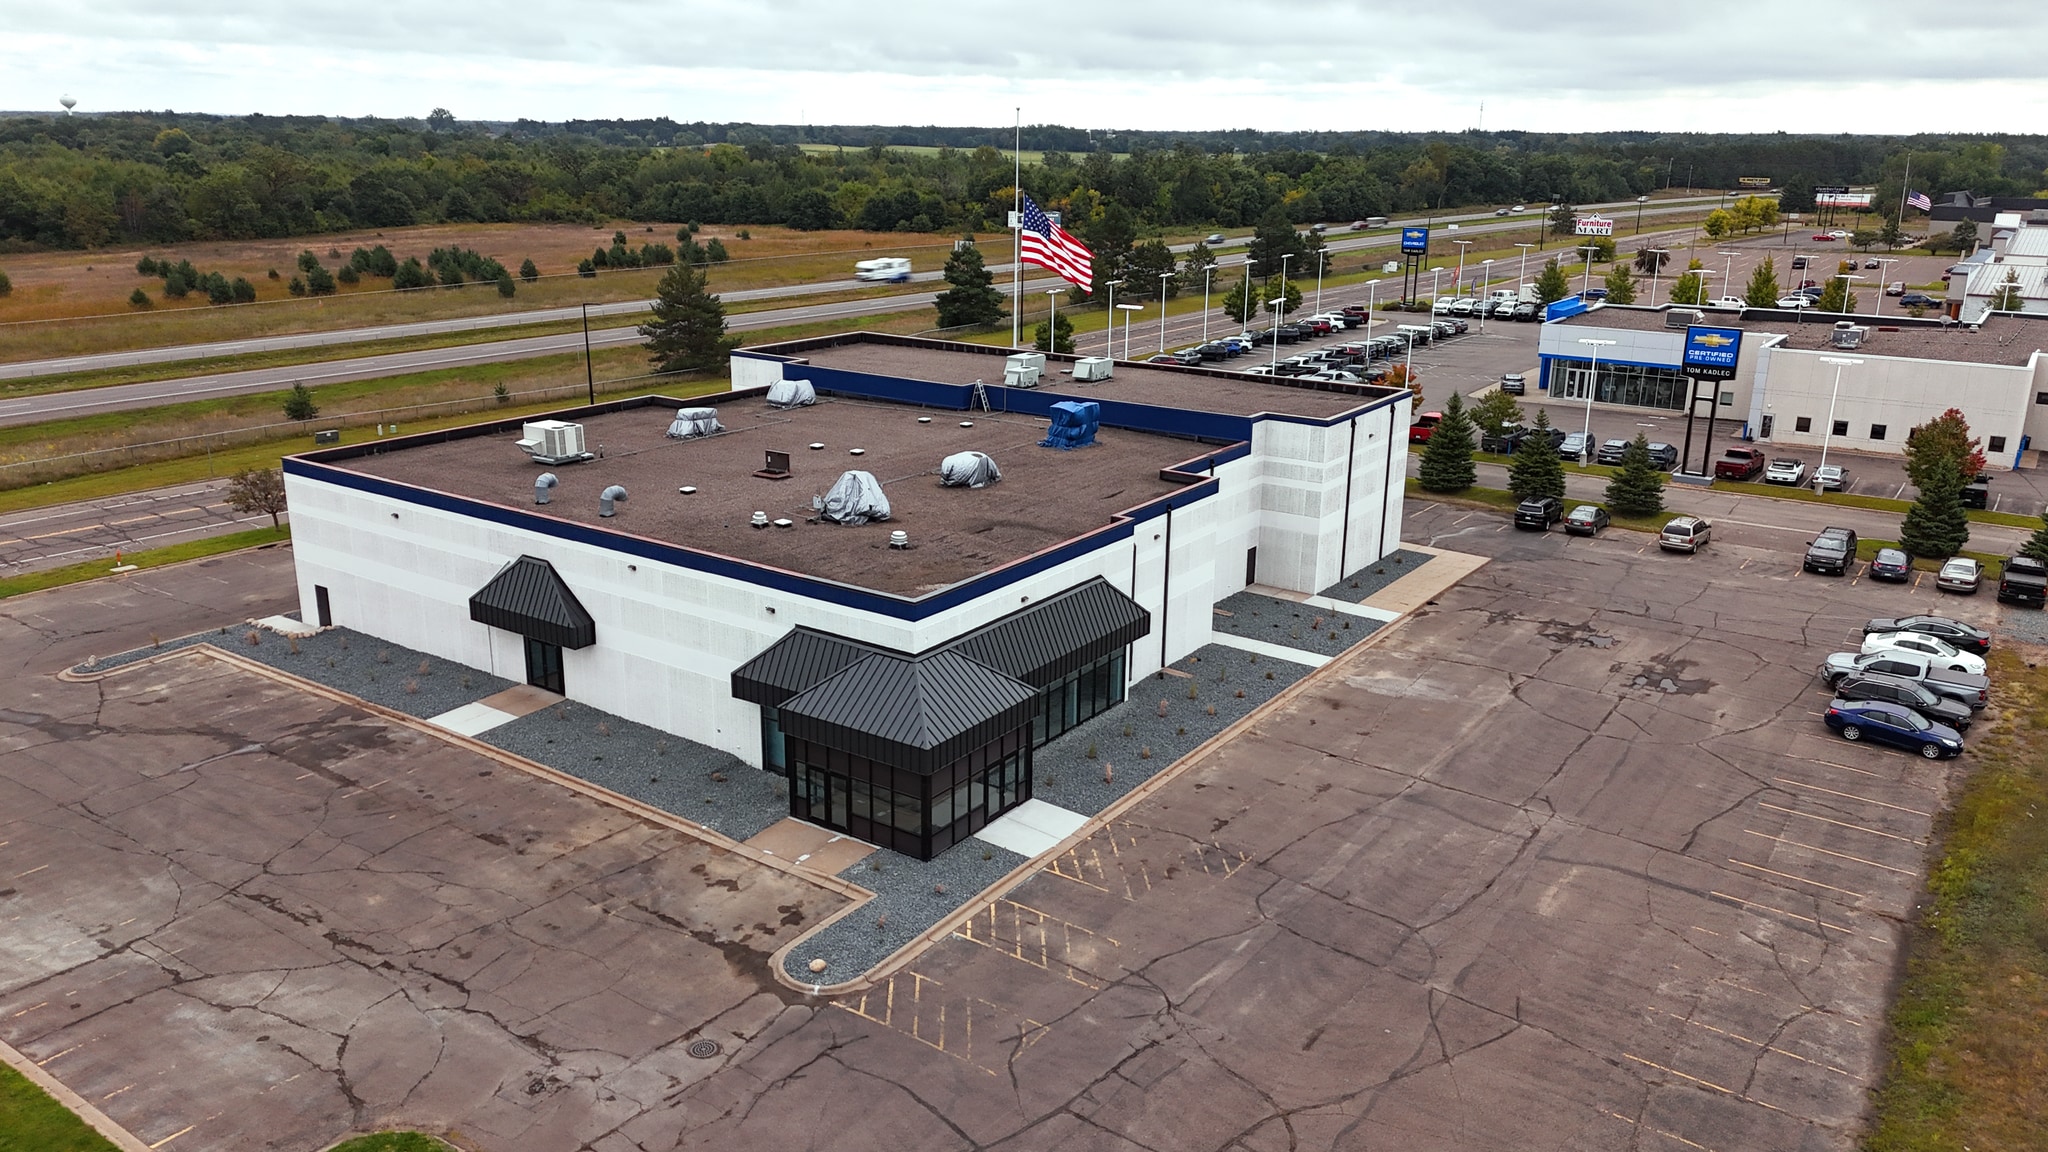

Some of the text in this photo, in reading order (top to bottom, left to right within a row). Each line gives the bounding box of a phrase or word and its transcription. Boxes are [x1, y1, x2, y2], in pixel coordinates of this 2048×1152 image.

[1577, 219, 1612, 227] Furniture
[1578, 227, 1610, 235] MART
[1688, 349, 1734, 358] CERTIFIED
[1702, 368, 1731, 377] KADLEC
